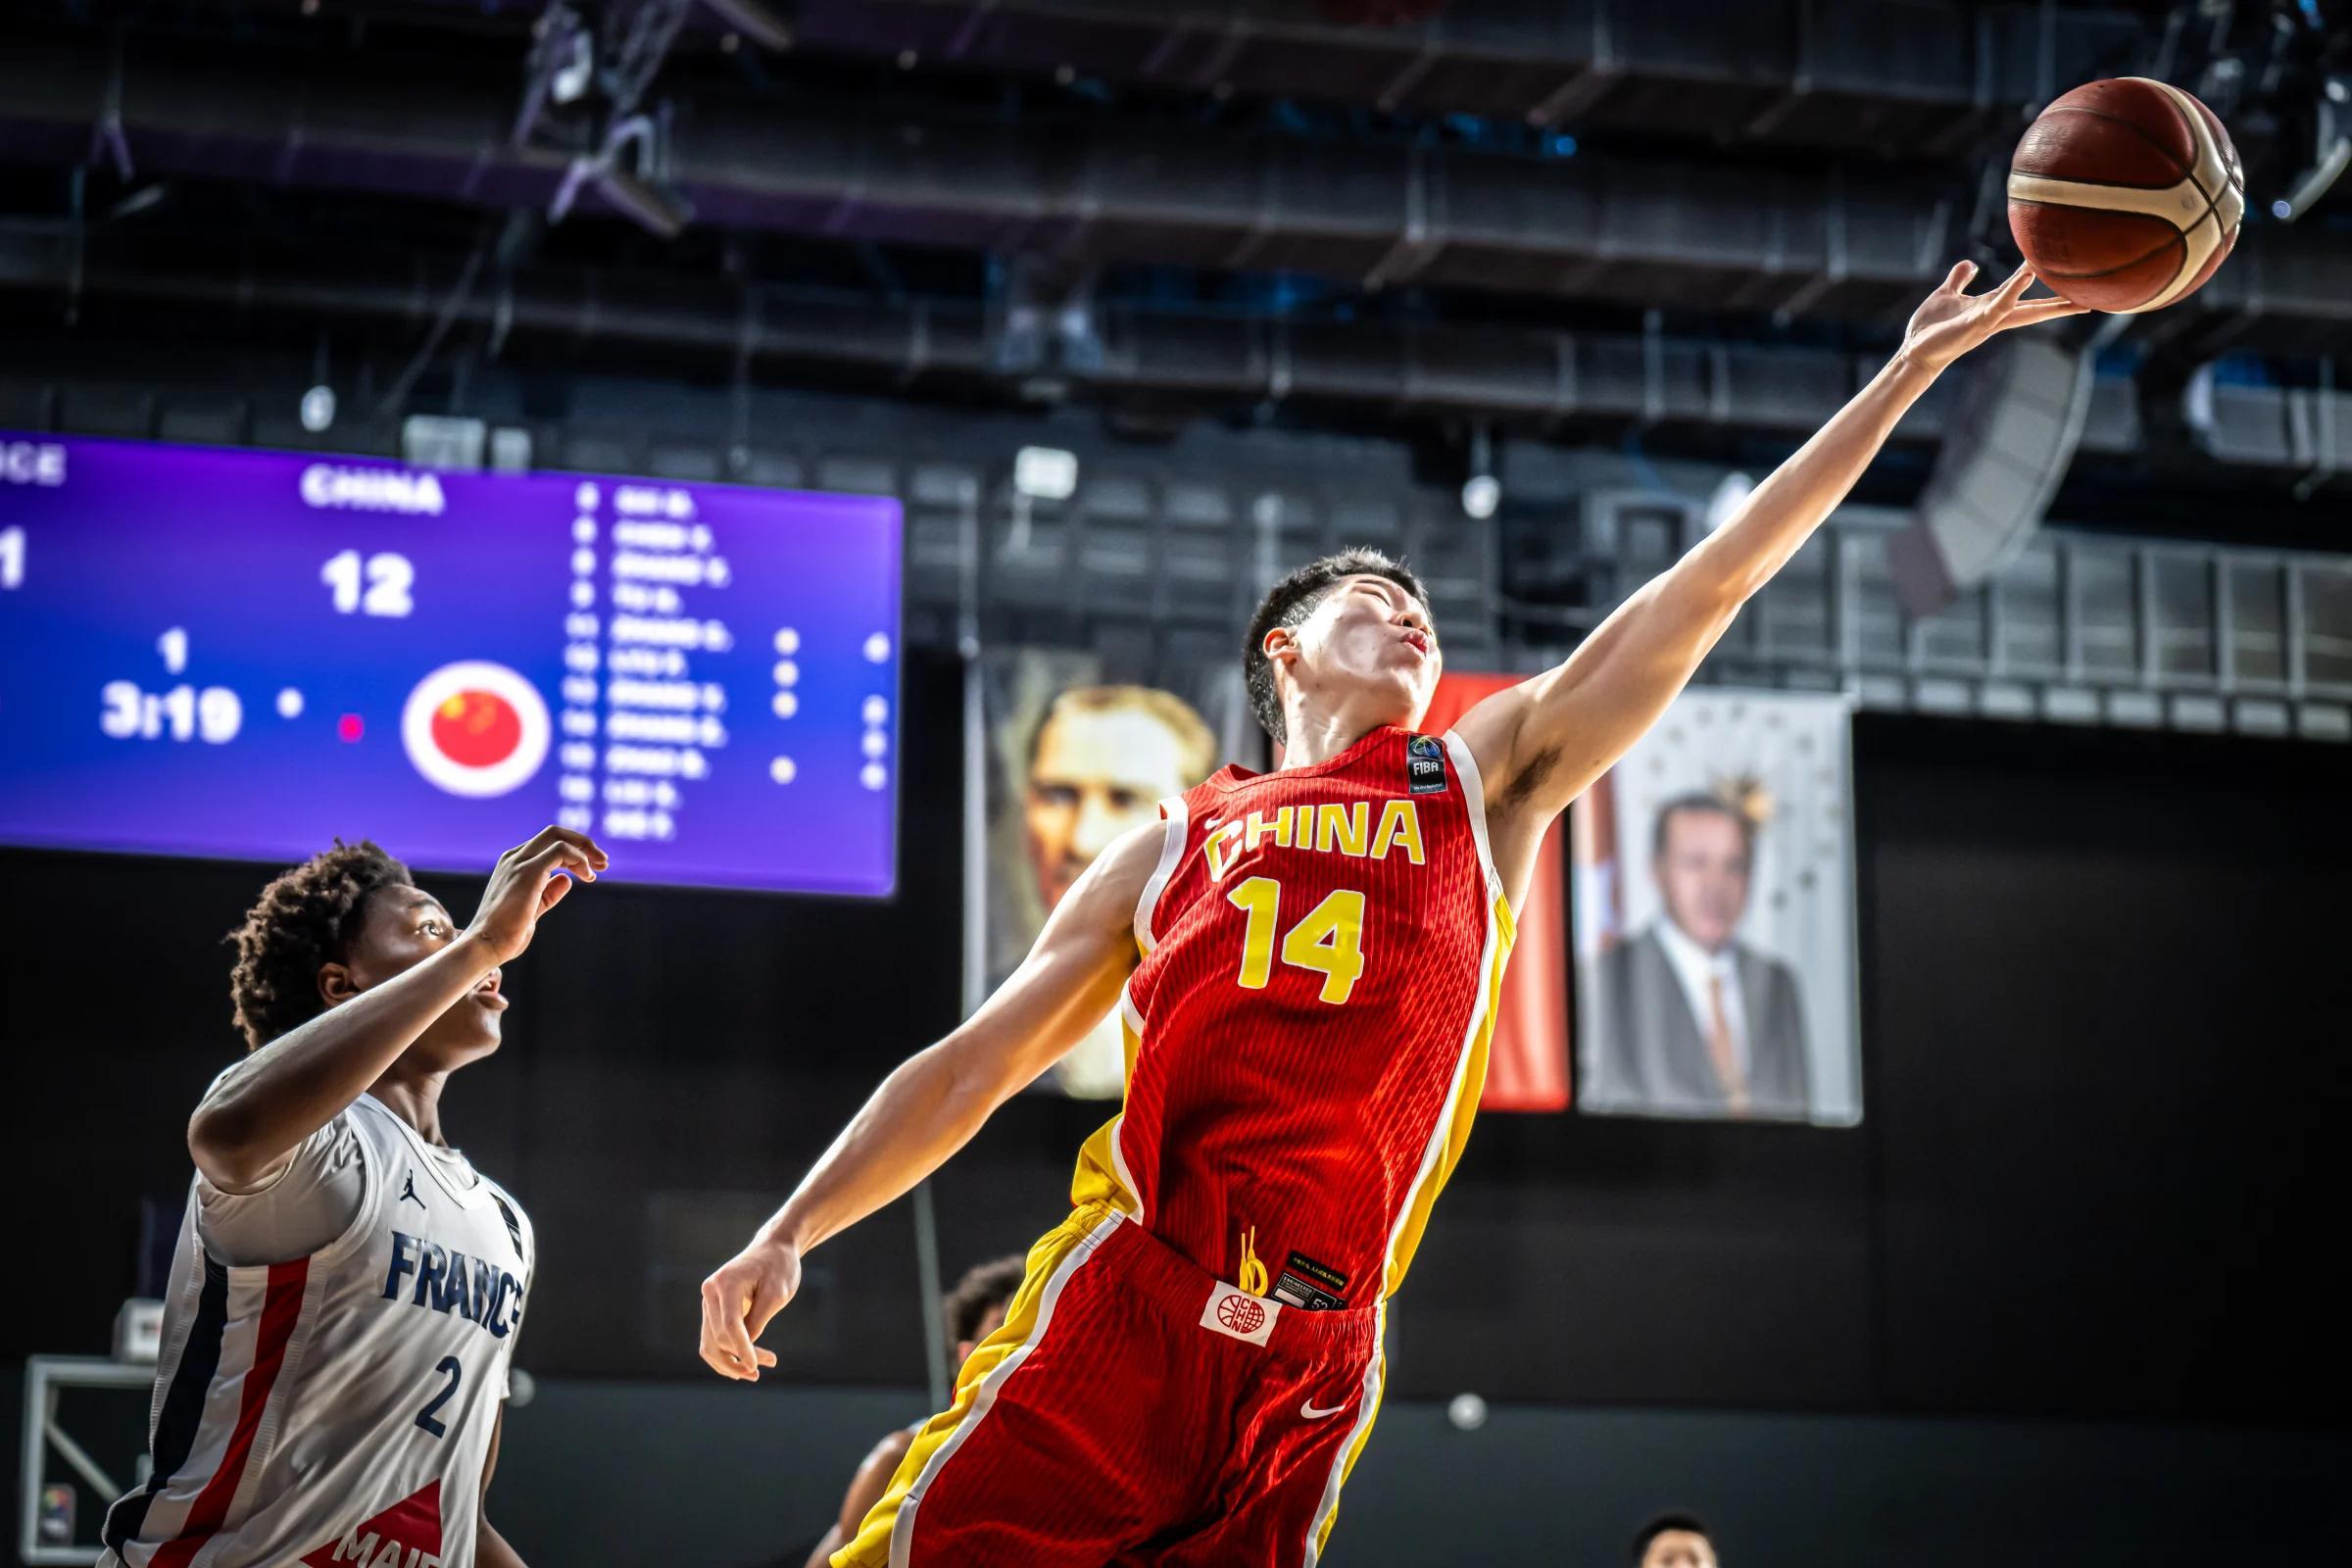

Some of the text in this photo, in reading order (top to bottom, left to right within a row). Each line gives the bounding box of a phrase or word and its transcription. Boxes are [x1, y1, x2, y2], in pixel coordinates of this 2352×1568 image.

[0, 442, 67, 485] CE
[322, 550, 414, 617] 12
[159, 627, 187, 674] 1
[1413, 761, 1439, 776] FIBA
[1203, 800, 1425, 882] CHINA
[1227, 876, 1365, 1004] 14
[414, 1355, 462, 1440] 2
